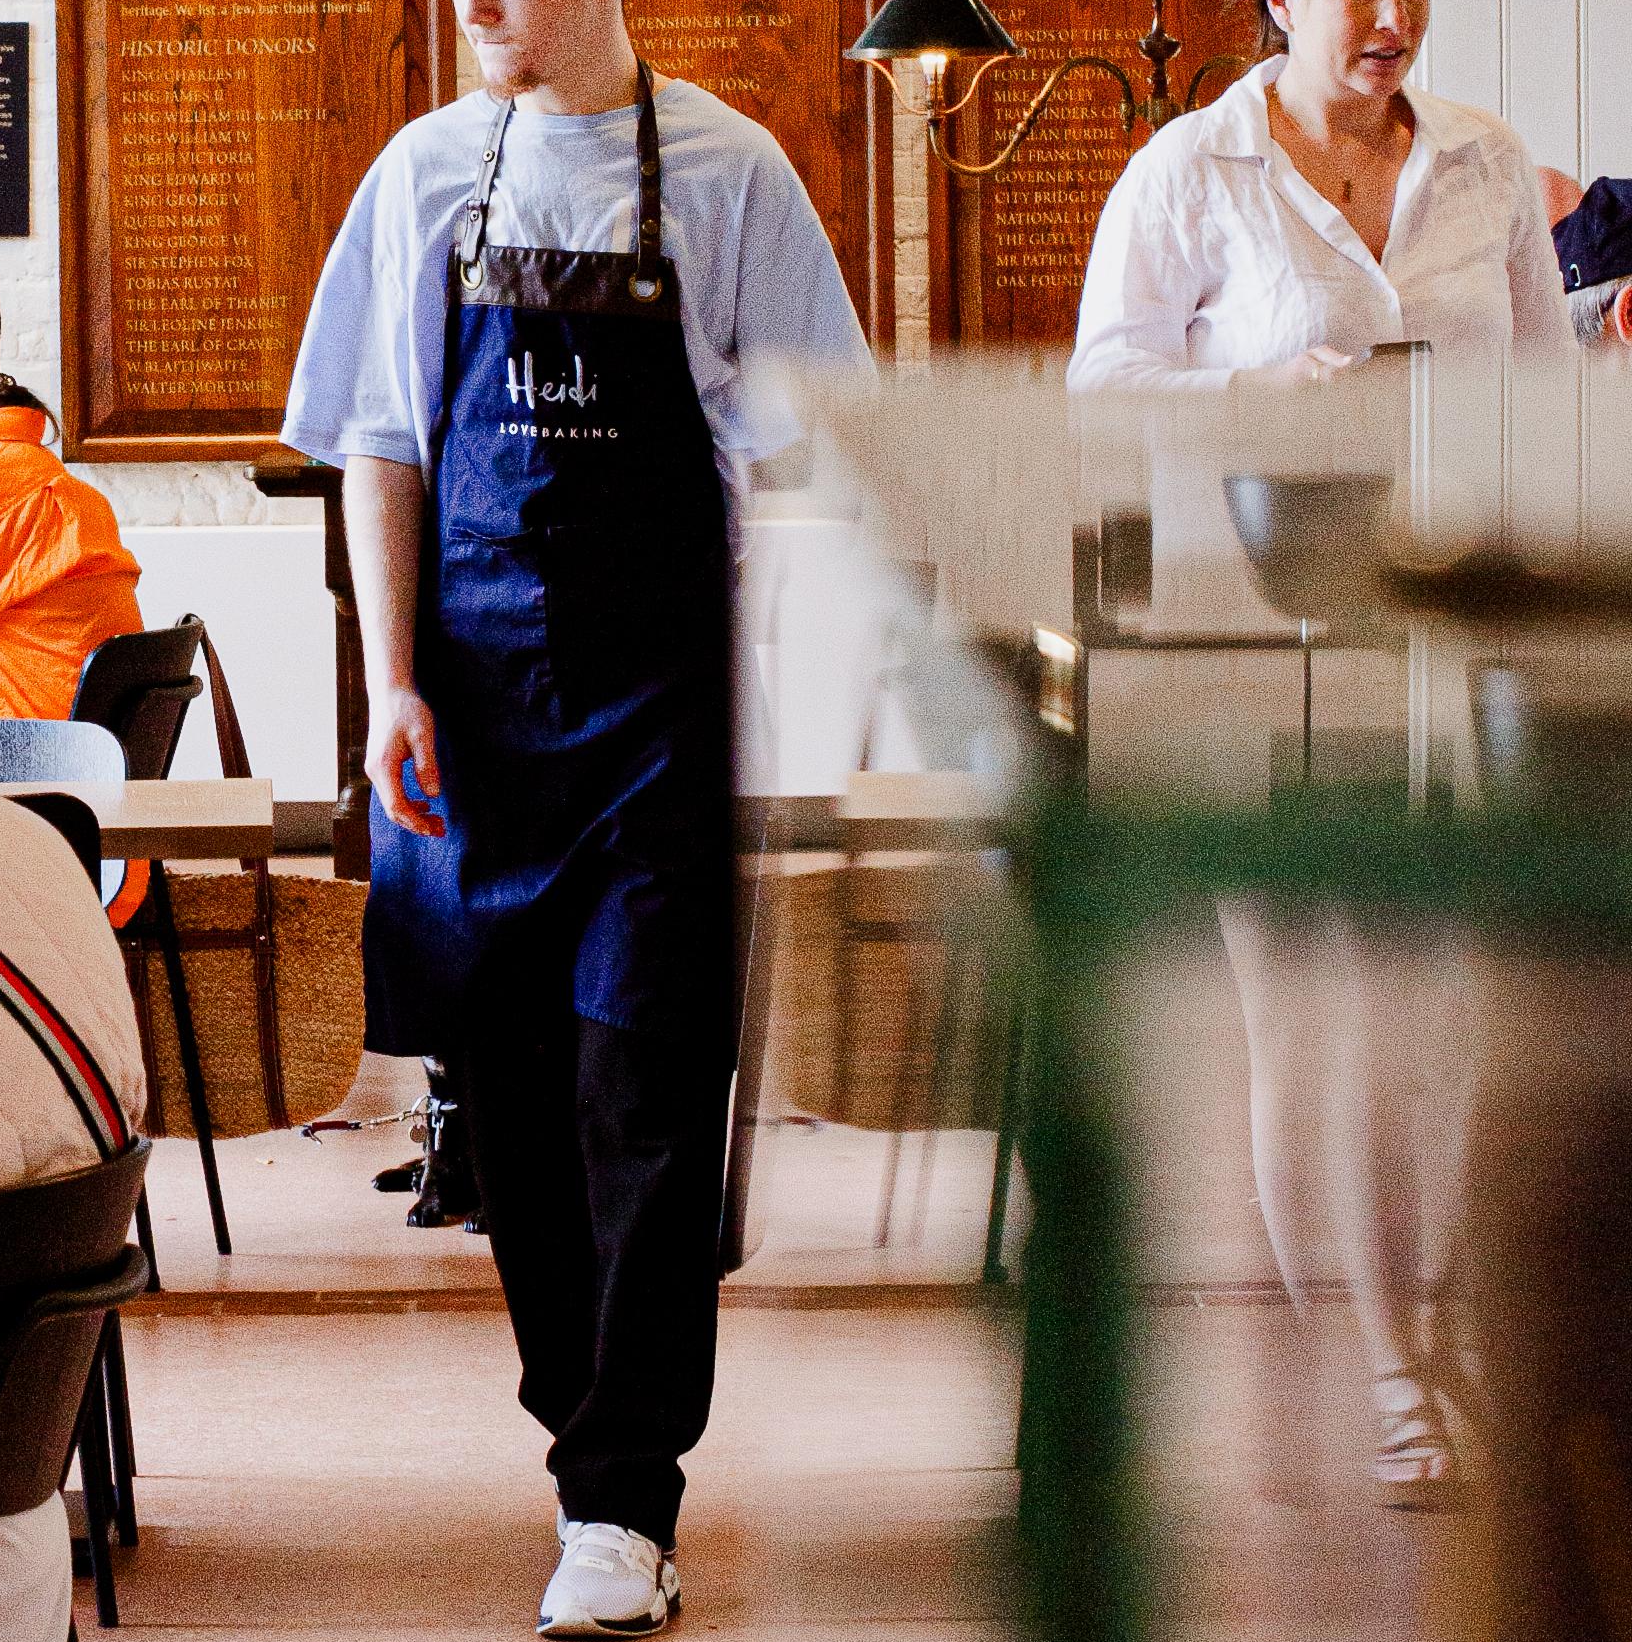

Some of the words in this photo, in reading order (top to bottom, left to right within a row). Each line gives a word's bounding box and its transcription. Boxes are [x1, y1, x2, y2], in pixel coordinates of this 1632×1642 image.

[175, 3, 194, 16] We
[198, 3, 215, 16] list
[259, 1, 278, 15] but
[283, 1, 316, 14] thank
[322, 1, 352, 13] them
[1058, 29, 1076, 41] OF
[1083, 28, 1110, 41] THE
[121, 38, 217, 57] HISTORIC
[226, 37, 317, 56] DONORS
[643, 38, 659, 50] W
[662, 37, 672, 49] H
[677, 37, 739, 49] COOPER
[121, 70, 161, 82] KING
[164, 68, 232, 81] CHARLES
[235, 68, 248, 80] II
[994, 69, 1038, 81] FOYLE
[719, 77, 761, 91] JONG
[122, 90, 161, 103] KING
[165, 89, 210, 102] JAMES
[214, 89, 224, 101] II
[994, 89, 1030, 102] MIKE
[122, 111, 161, 124] KING
[164, 110, 230, 123] WILLIAM
[236, 110, 250, 122] III
[255, 110, 266, 121] &
[270, 108, 312, 121] MARY
[316, 108, 327, 120] II
[123, 132, 161, 145] KING
[165, 131, 232, 144] WILLIAM
[236, 131, 251, 143] IV
[1064, 127, 1117, 140] PURDIE
[123, 153, 175, 167] QUEEN
[180, 152, 254, 165] VICTORIA
[1028, 149, 1088, 161] FRANCIS
[123, 174, 163, 187] KING
[166, 173, 231, 185] EDWARD
[234, 172, 255, 185] VII
[124, 194, 163, 207] KING
[166, 193, 228, 207] GEORGE
[232, 194, 242, 205] V
[995, 192, 1029, 204] CITY
[1034, 191, 1088, 203] BRIDGE
[124, 215, 177, 230] QUEEN
[181, 215, 222, 227] MARY
[996, 212, 1071, 225] NATIONAL
[125, 236, 163, 248] KING
[167, 235, 228, 248] GEORGE
[232, 234, 249, 245] VI
[997, 234, 1024, 246] THE
[125, 257, 146, 269] SIR
[151, 256, 220, 269] STEPHEN
[224, 256, 253, 268] FOX
[996, 255, 1019, 266] MR
[1023, 254, 1083, 266] PATRICK
[126, 278, 179, 290] TOBIAS
[183, 276, 240, 290] RUSTAT
[996, 276, 1027, 287] OAK
[126, 299, 156, 311] THE
[161, 298, 197, 311] EARL
[202, 297, 221, 310] OF
[227, 296, 289, 310] THANET
[126, 320, 149, 332] SIR
[152, 318, 216, 331] LEOLINE
[220, 316, 283, 330] JENKINS
[126, 340, 156, 353] THE
[161, 340, 198, 352] EARL
[203, 339, 223, 352] OF
[227, 337, 286, 351] CRAVEN
[127, 361, 140, 373] W
[506, 351, 597, 409] Heidi
[127, 382, 186, 395] WALTER
[191, 380, 273, 394] MORTIMER
